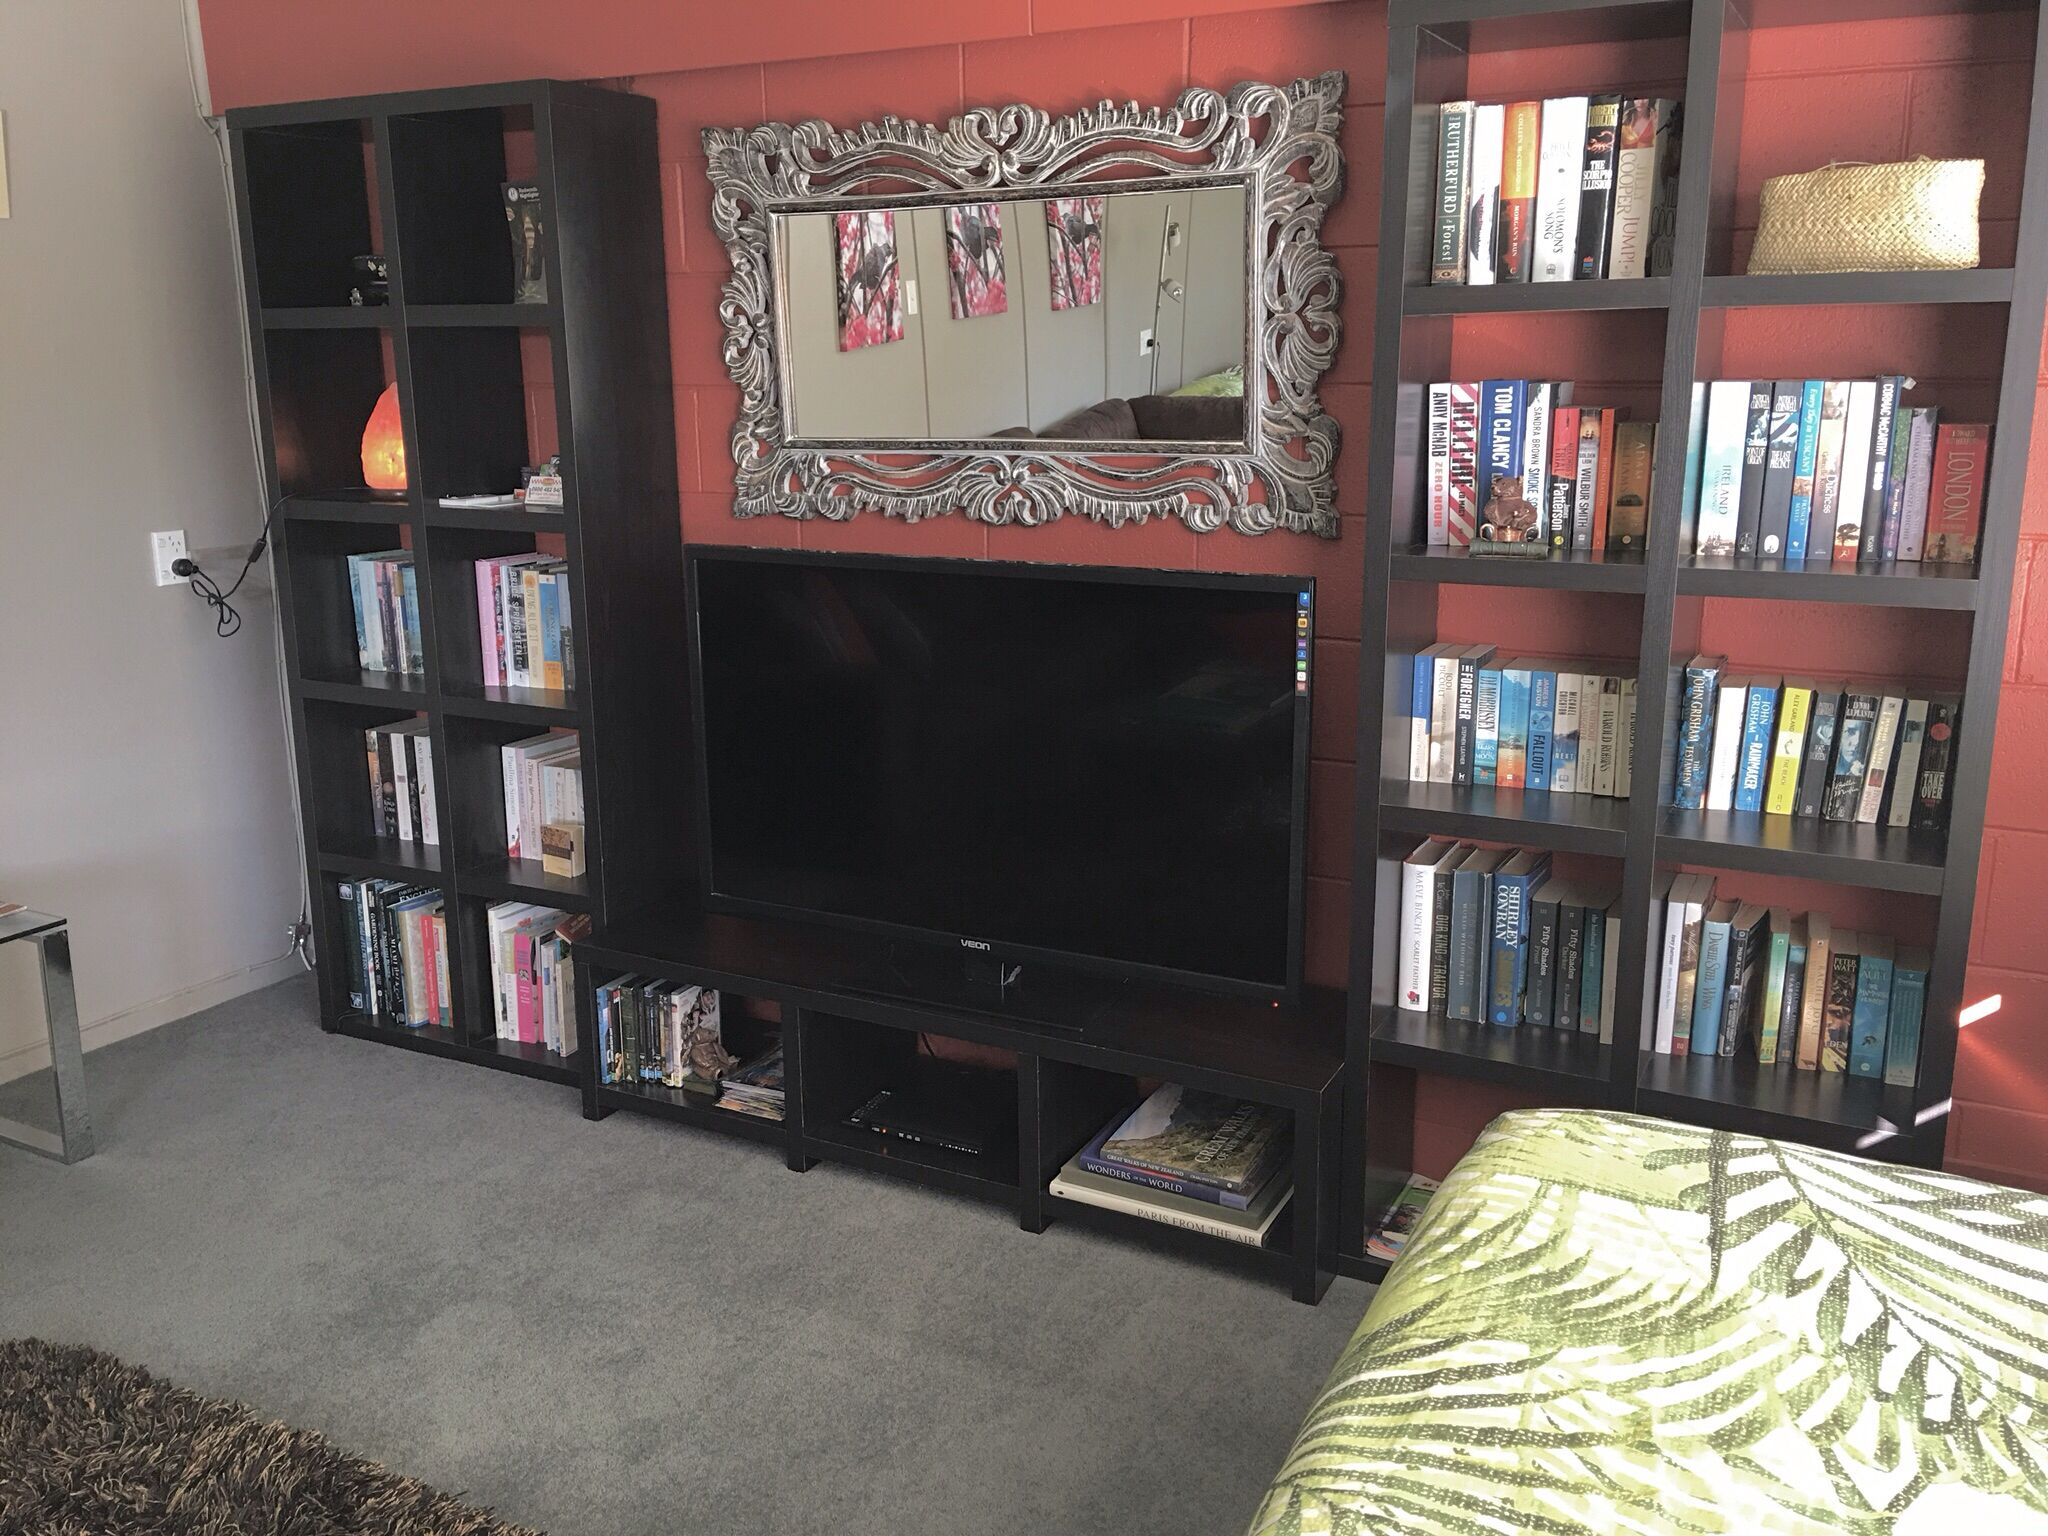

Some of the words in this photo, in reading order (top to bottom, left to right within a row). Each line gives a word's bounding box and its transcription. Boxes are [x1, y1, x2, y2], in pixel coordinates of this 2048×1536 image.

[1444, 122, 1460, 214] RUTHERFURD
[1590, 160, 1605, 170] THE
[1618, 152, 1638, 216] COOPER
[1636, 164, 1648, 200] JILLY
[1544, 212, 1556, 240] SONG
[1553, 198, 1566, 254] SOLOMON'S
[1619, 216, 1640, 264] JUMP!
[1442, 224, 1456, 261] Forest
[1433, 392, 1448, 418] ANDY
[1495, 386, 1514, 414] TOM
[1880, 383, 1894, 416] CORMAC
[1533, 406, 1543, 436] SANDRA
[1875, 416, 1890, 456] McCARTHY
[1432, 423, 1447, 458] McNAB
[1452, 402, 1475, 488] HELLFIRE
[1493, 418, 1512, 469] CLANCY
[1531, 438, 1541, 465] BROWN
[1801, 434, 1812, 474] TUSCANY
[1435, 462, 1444, 490] ZERO
[1554, 448, 1567, 474] TRIAL
[1528, 468, 1540, 494] SMOKE
[1581, 468, 1592, 500] WILBUR
[1718, 464, 1732, 516] IRELAND
[1823, 474, 1838, 514] Duchess
[1944, 451, 1976, 521] LONDON
[1434, 495, 1444, 528] HOUR
[1552, 482, 1569, 531] Patterson
[1563, 504, 1571, 518] James
[1578, 502, 1589, 528] SMITH
[510, 571, 520, 598] BRUCE
[512, 601, 522, 654] SPRINGSTEEN
[1438, 664, 1447, 698] PICOULT
[1445, 672, 1454, 690] JODI
[1459, 672, 1474, 720] FOREIGNER
[1691, 675, 1706, 700] JOHN
[1478, 684, 1497, 732] MORRISSEY
[1568, 691, 1578, 716] MICHAEL
[1748, 694, 1762, 733] GRISHAM
[1760, 700, 1770, 725] JOHN
[1789, 706, 1798, 732] GARLAND
[1602, 710, 1614, 742] HAROLD
[1688, 701, 1704, 742] GRISHAM
[1532, 734, 1546, 775] FALLOUT
[1683, 745, 1696, 787] TESTAMENT
[1744, 742, 1764, 790] RAINMAKER
[1922, 786, 1942, 800] OVER
[1923, 772, 1944, 788] TAKE
[1415, 870, 1424, 899] MAEVE
[1414, 902, 1424, 936] BINCHY
[1438, 914, 1449, 932] OUR
[1496, 884, 1509, 940] CONRAN
[1506, 886, 1521, 950] SHIRLEY
[370, 912, 379, 951] GARDENING
[960, 939, 990, 951] VEON
[1436, 934, 1448, 954] KIND
[1542, 926, 1550, 945] Fifty
[1568, 928, 1578, 948] Fifty
[390, 938, 398, 964] MIAMI
[1540, 946, 1549, 976] Shades
[1567, 950, 1577, 980] Shades
[1834, 958, 1857, 966] PETER
[1433, 964, 1447, 998] TRAITOR
[1815, 964, 1824, 1001] RACHEL
[1834, 964, 1856, 972] WATT
[1813, 1006, 1822, 1036] JOYCE
[1194, 1133, 1230, 1164] GREAT
[1219, 1105, 1256, 1132] WALKS
[1087, 1162, 1131, 1181] WONDERS
[1149, 1179, 1182, 1193] WORLD
[1106, 1154, 1123, 1162] GREAT
[1123, 1158, 1140, 1166] WALKS
[1160, 1165, 1184, 1177] ZEALAND
[1138, 1208, 1169, 1224] PARIS
[1172, 1217, 1205, 1232] FROM
[1208, 1226, 1231, 1238] THE
[1236, 1235, 1256, 1245] AIR
